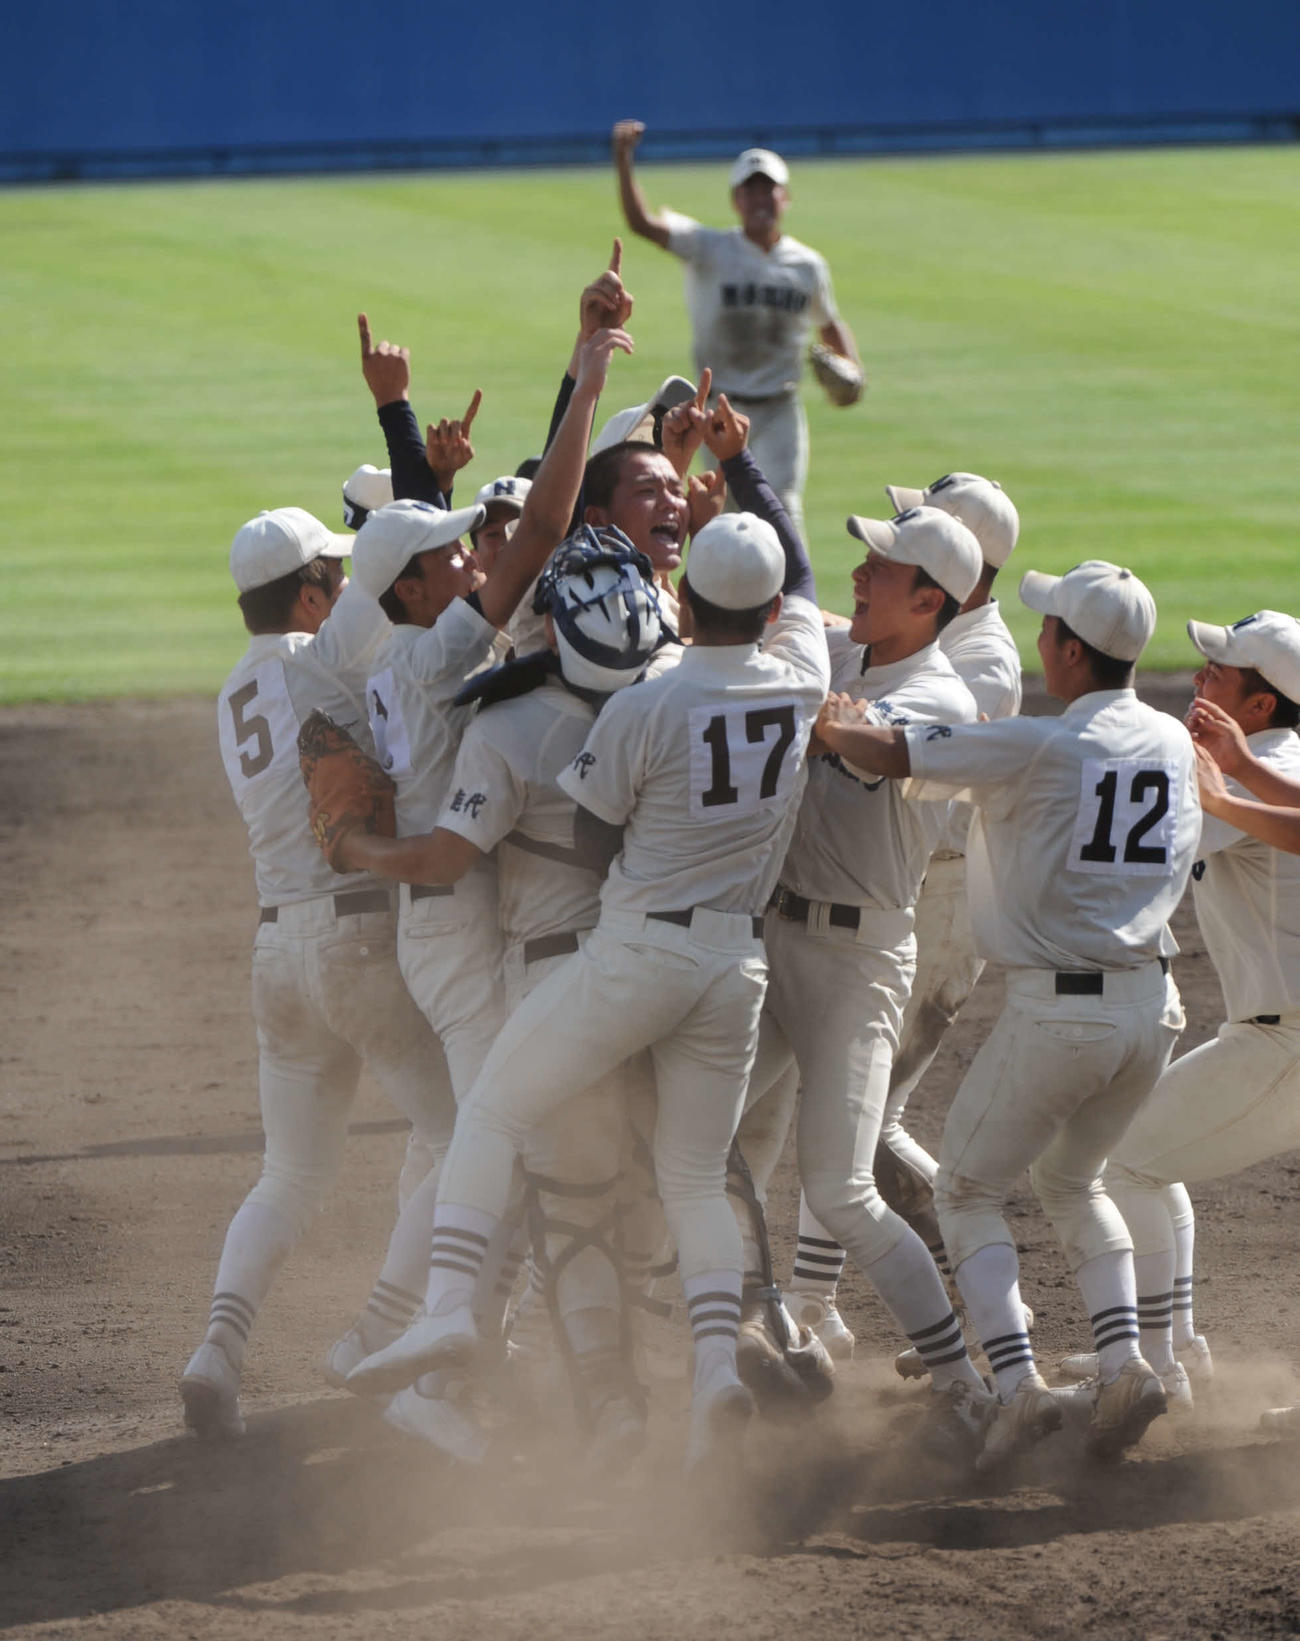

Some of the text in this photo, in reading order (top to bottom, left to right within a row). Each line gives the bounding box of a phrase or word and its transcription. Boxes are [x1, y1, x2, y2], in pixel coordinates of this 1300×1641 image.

[494, 481, 515, 496] N
[229, 679, 275, 778] 5
[702, 705, 796, 807] 17
[1080, 770, 1170, 864] 12
